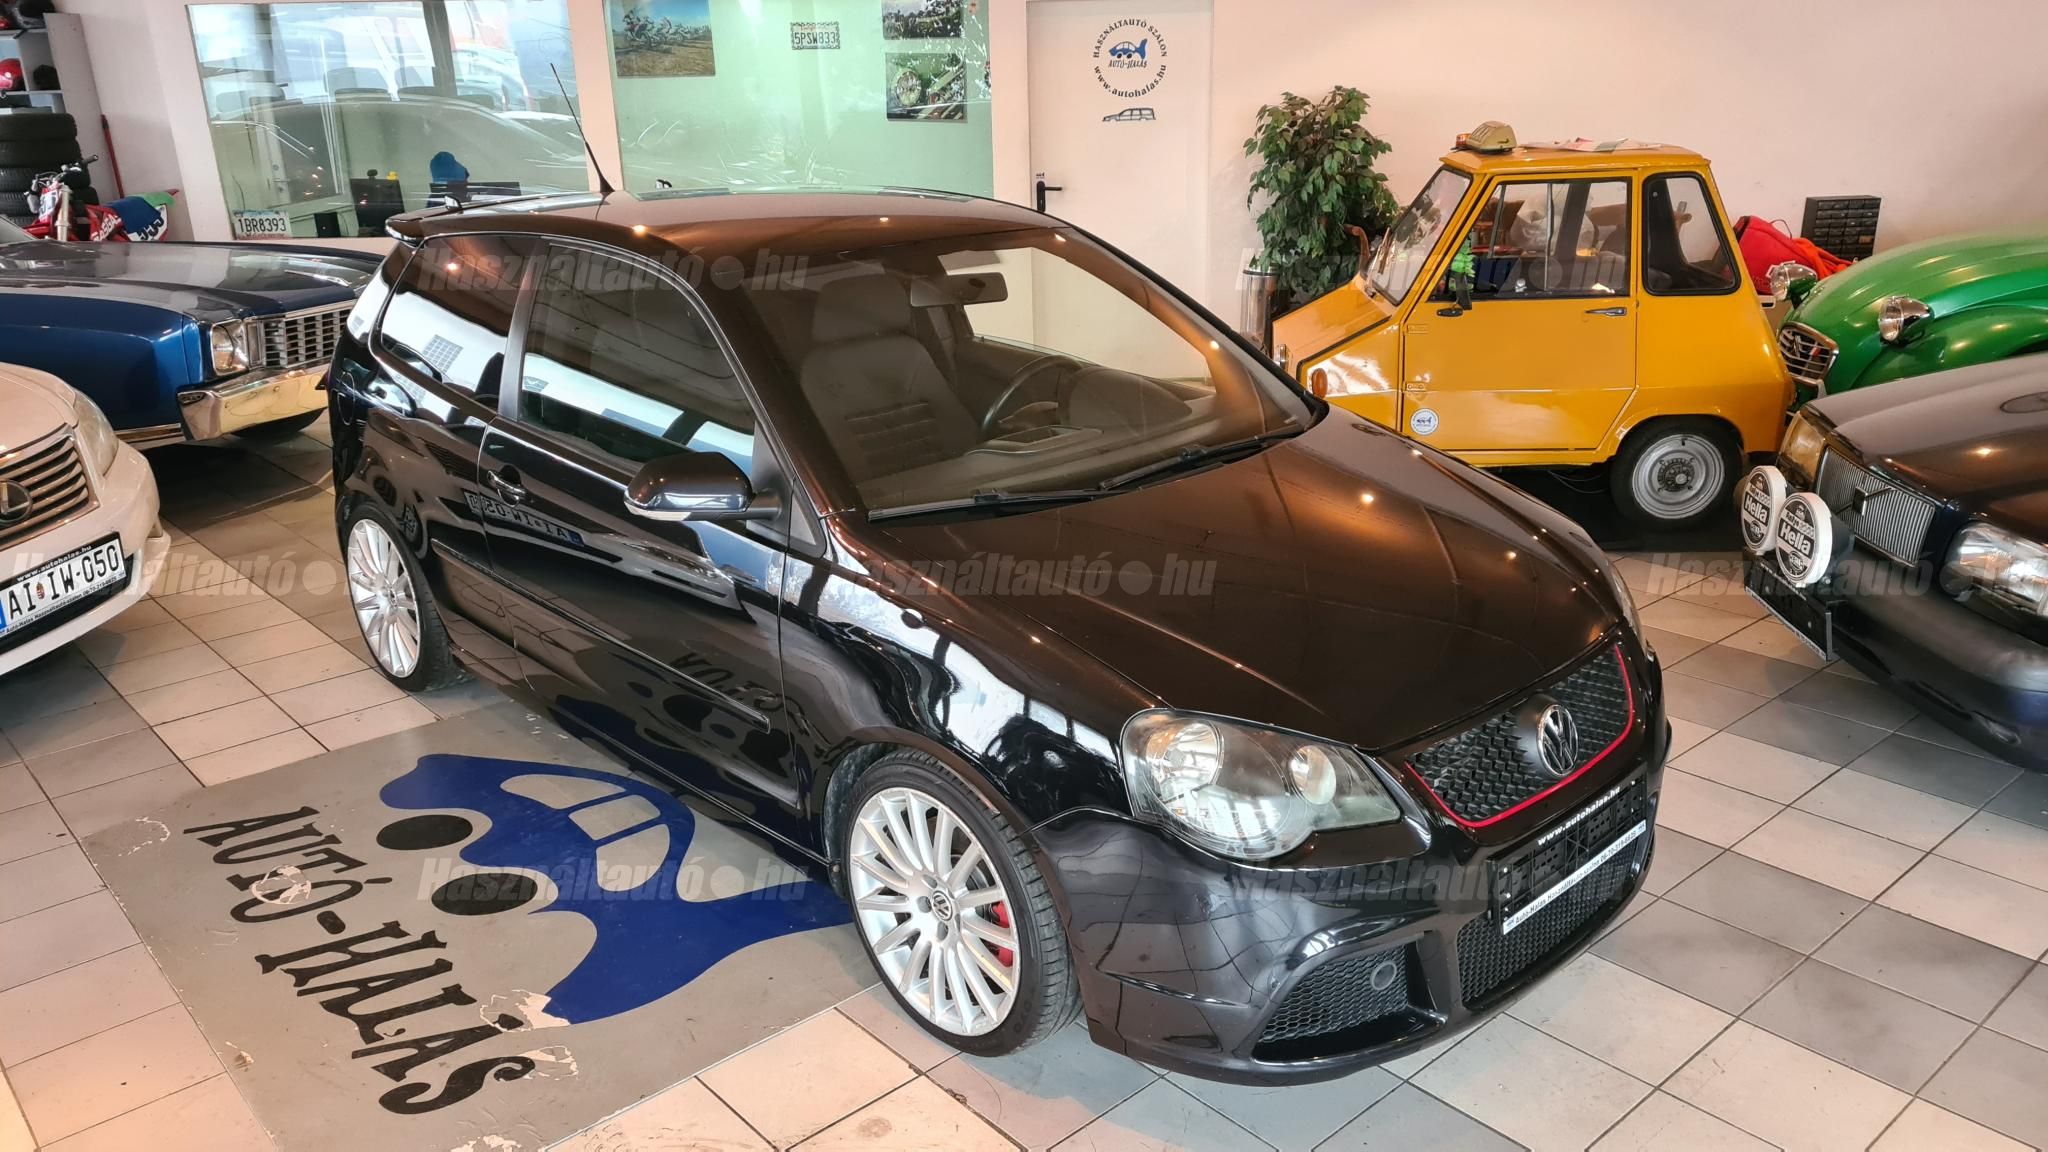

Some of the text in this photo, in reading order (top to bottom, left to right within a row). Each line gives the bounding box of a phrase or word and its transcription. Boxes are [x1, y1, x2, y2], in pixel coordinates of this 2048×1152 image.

[1147, 25, 1168, 57] SZALON
[1094, 64, 1167, 98] www.autohalas.hu
[238, 217, 287, 233] 1BR8393
[1744, 494, 1768, 523] Hella
[1780, 521, 1811, 556] Hella
[17, 545, 92, 582] www.autohalas.hu
[8, 544, 120, 620] AI IW-050
[1537, 785, 1621, 847] www.autohalas.hu
